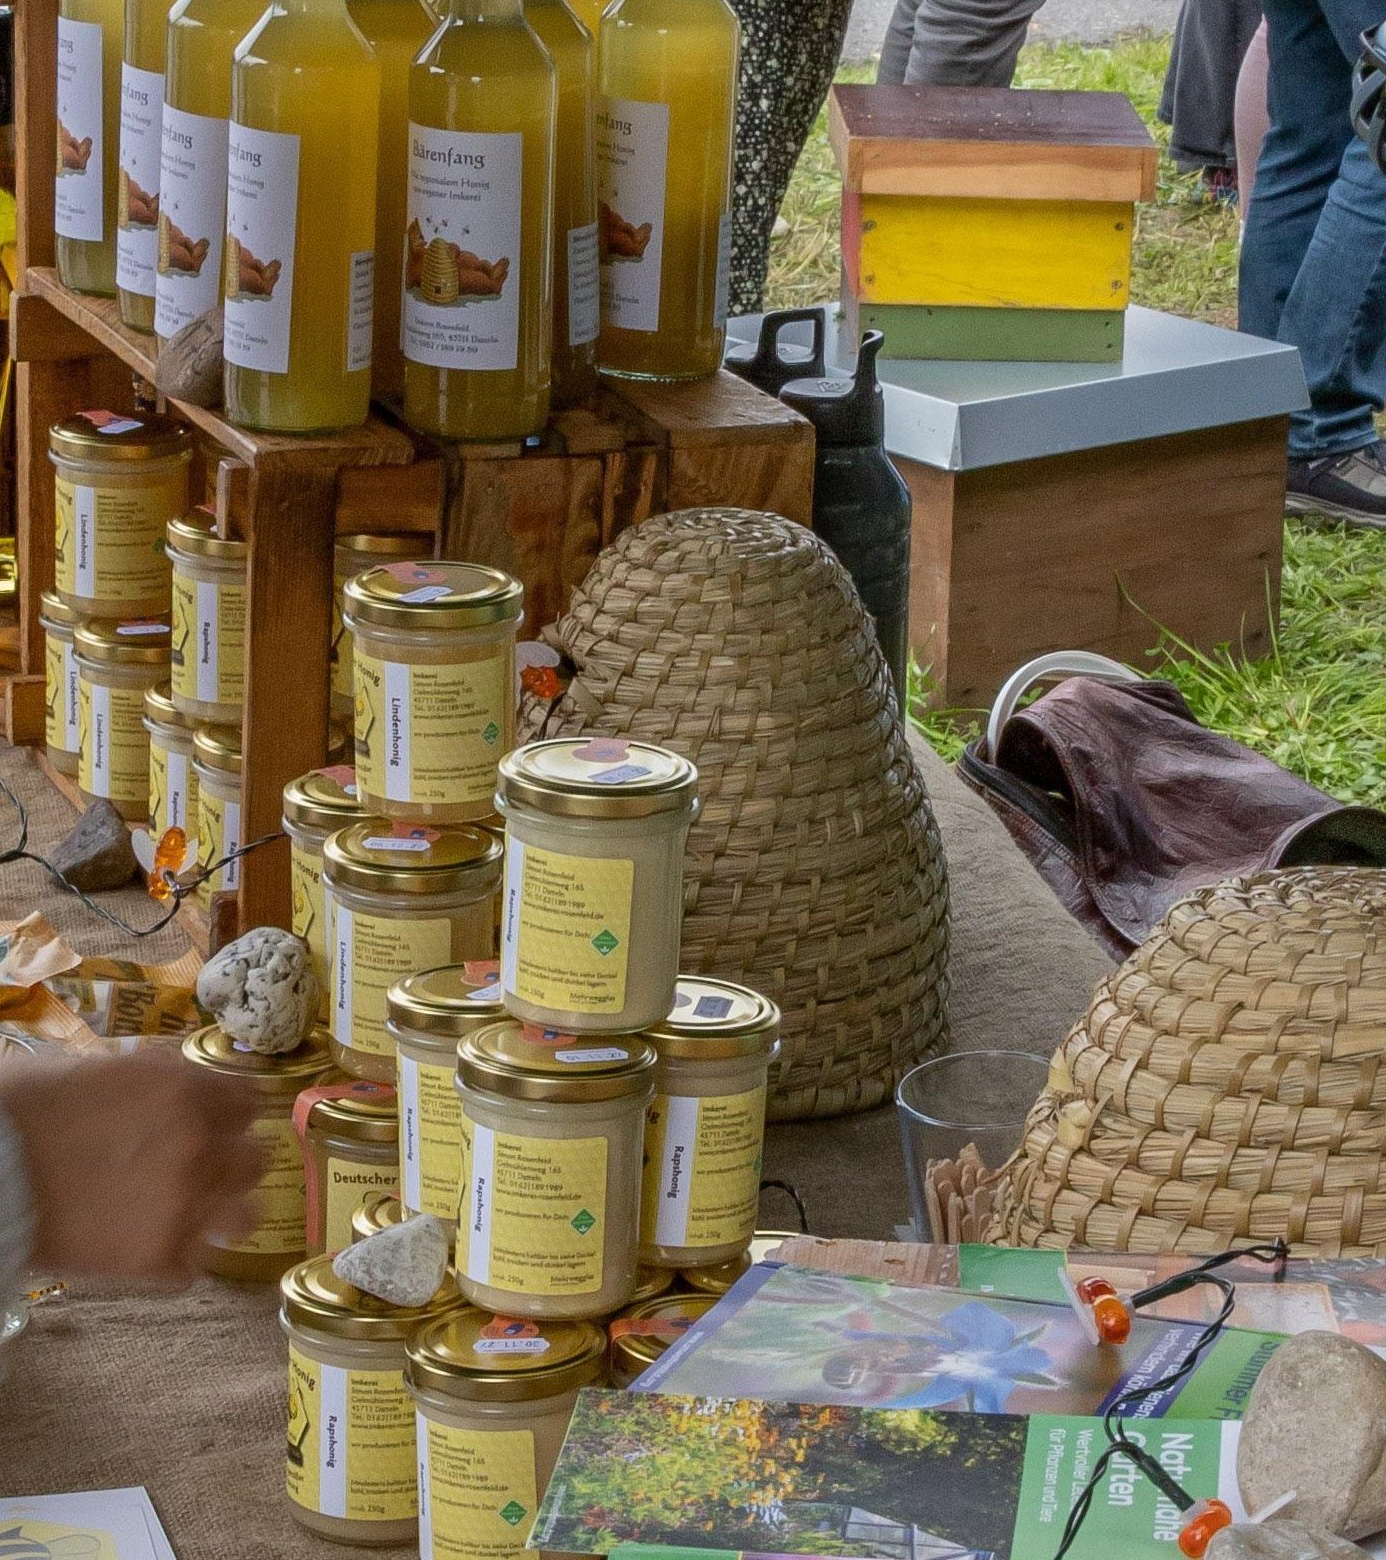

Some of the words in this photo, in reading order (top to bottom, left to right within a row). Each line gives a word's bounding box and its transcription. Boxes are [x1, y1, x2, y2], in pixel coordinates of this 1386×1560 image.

[413, 138, 486, 170] Bärenfang
[461, 178, 490, 190] Honig
[390, 697, 403, 768] Lindenhonig
[338, 941, 347, 1010] Lindenhonig
[516, 1154, 552, 1164] Rosenfeld
[666, 1145, 685, 1200] Rapshonig
[333, 1171, 398, 1185] Deutscher
[473, 1176, 485, 1233] Rapshonig
[1136, 1328, 1183, 1374] verhindern
[351, 1377, 379, 1387] Imkerei
[326, 1415, 338, 1468] Rapshonig
[1049, 1428, 1066, 1444] für
[1044, 1443, 1065, 1486] Pflanzen
[1072, 1428, 1095, 1482] Wertvoller
[1039, 1503, 1058, 1524] Tiere
[1041, 1486, 1059, 1504] und
